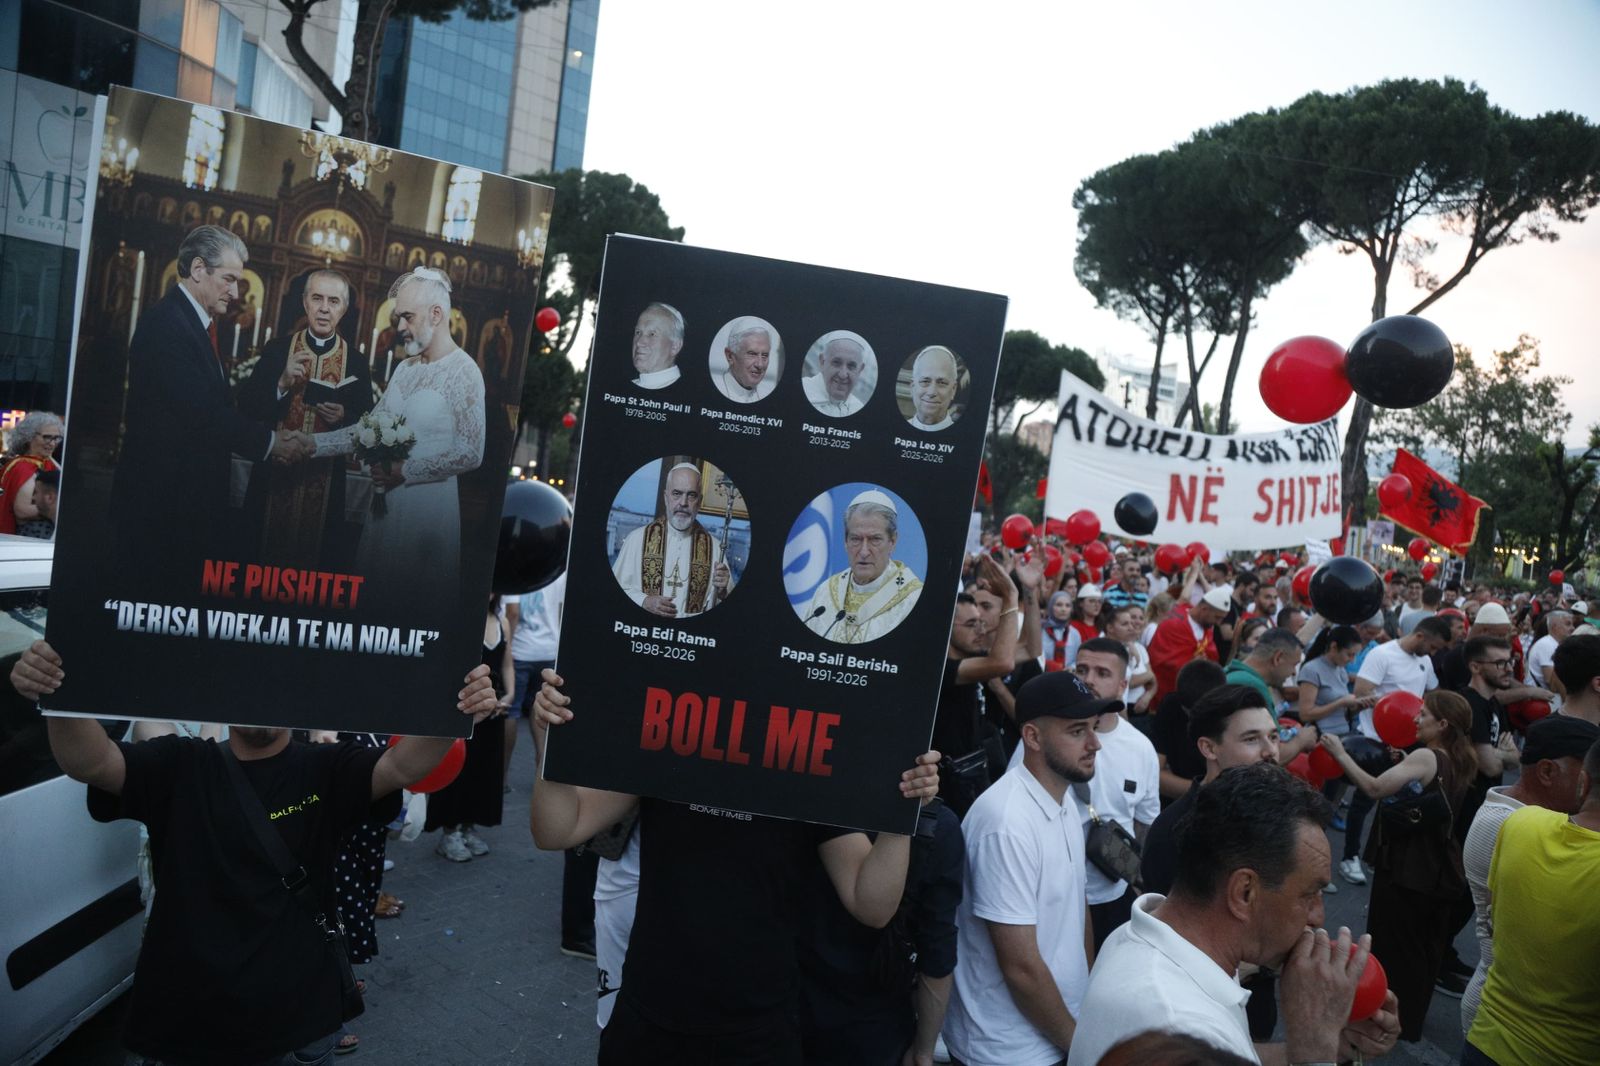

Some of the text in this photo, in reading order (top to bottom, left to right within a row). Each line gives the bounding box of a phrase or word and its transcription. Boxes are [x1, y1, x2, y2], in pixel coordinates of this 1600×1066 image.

[604, 393, 691, 414] Papa St John Paul II
[625, 408, 667, 422] 1978-2005
[701, 408, 783, 428] Papa Benedict XVI
[718, 422, 761, 436] 2005-2013
[802, 423, 862, 440] Papa Francis
[809, 436, 850, 450] 2013-2025
[894, 437, 954, 453] Papa Leo XIV
[901, 450, 944, 464] 2025-2026
[1166, 466, 1341, 526] NË SHITJE
[202, 559, 364, 610] NE PUSHTET
[104, 598, 440, 658] “DERISA VDEKJA TE NA NDAJE”
[614, 620, 716, 648] Papa Edi Rama
[630, 640, 696, 662] 1998-2026
[780, 646, 898, 674] Papa Sali Berisha
[806, 667, 868, 688] 1991-2026
[640, 686, 841, 777] BOLL ME
[689, 803, 752, 822] SOMETIMES
